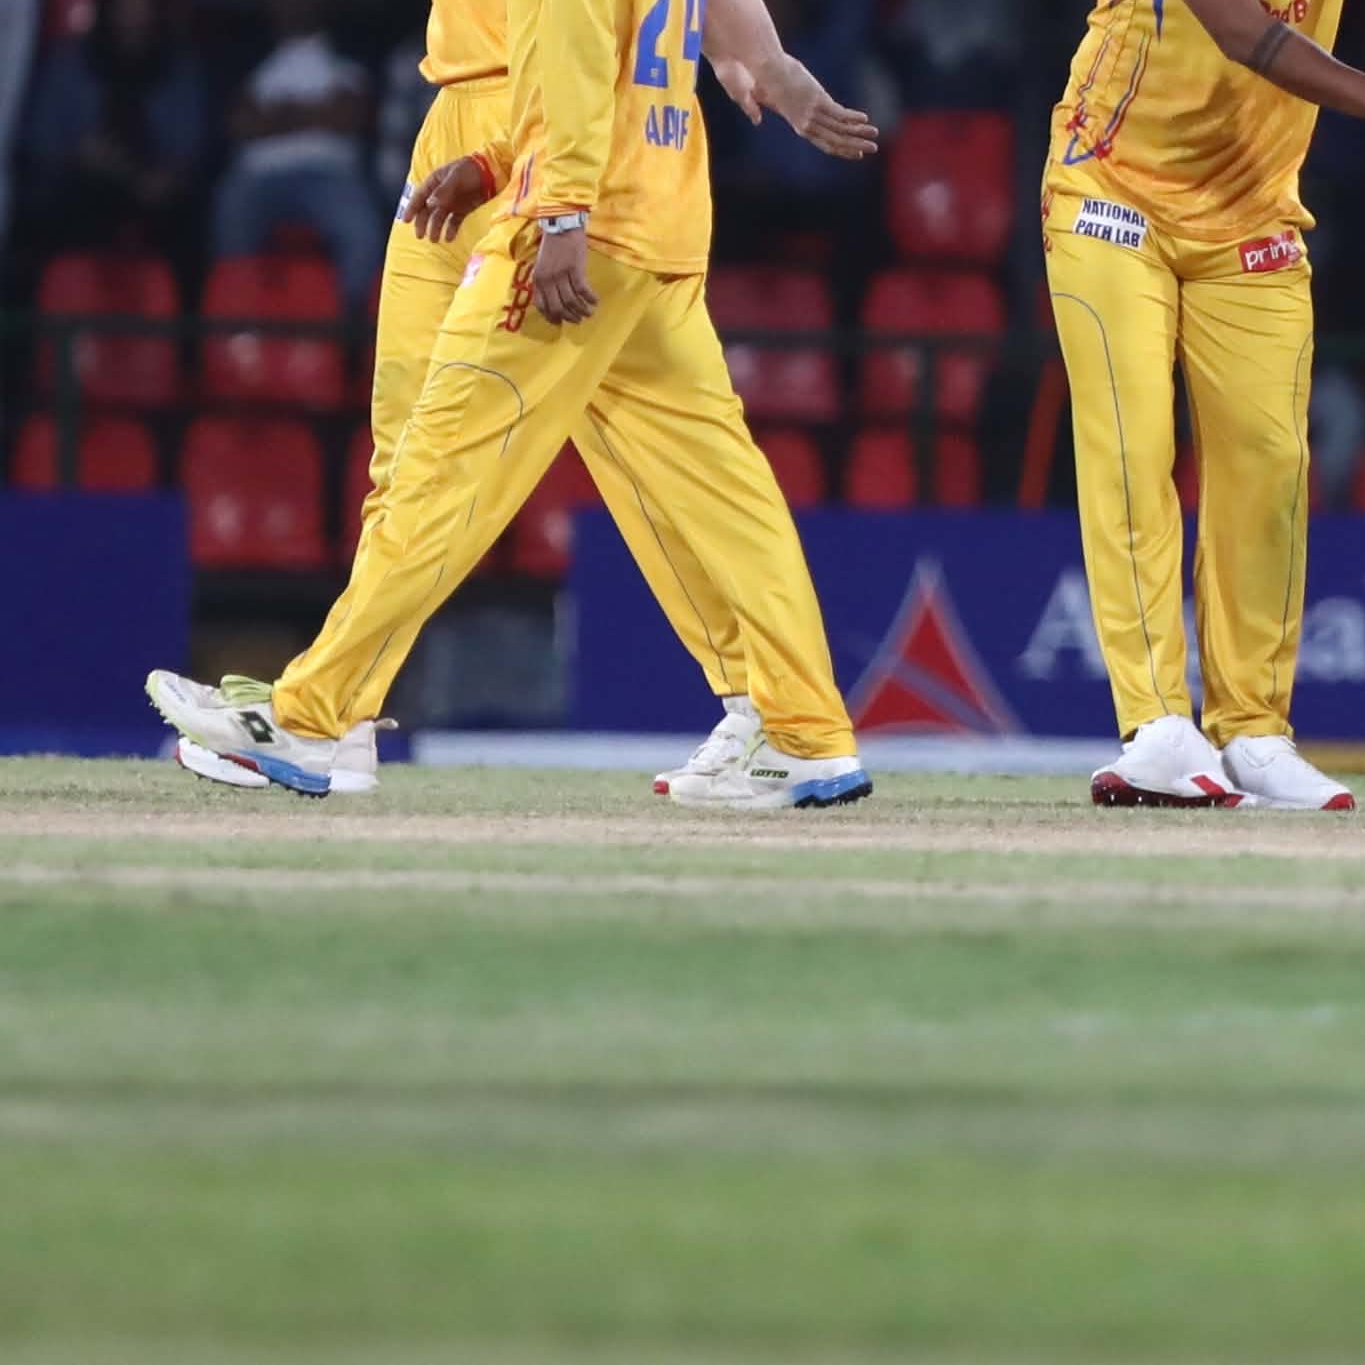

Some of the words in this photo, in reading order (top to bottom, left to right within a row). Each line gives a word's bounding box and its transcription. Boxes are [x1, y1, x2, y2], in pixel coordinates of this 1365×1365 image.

[1082, 199, 1148, 228] NATIONAL
[1075, 219, 1112, 243] PATH
[1114, 228, 1142, 248] LAB
[749, 768, 789, 779] LOTTO
